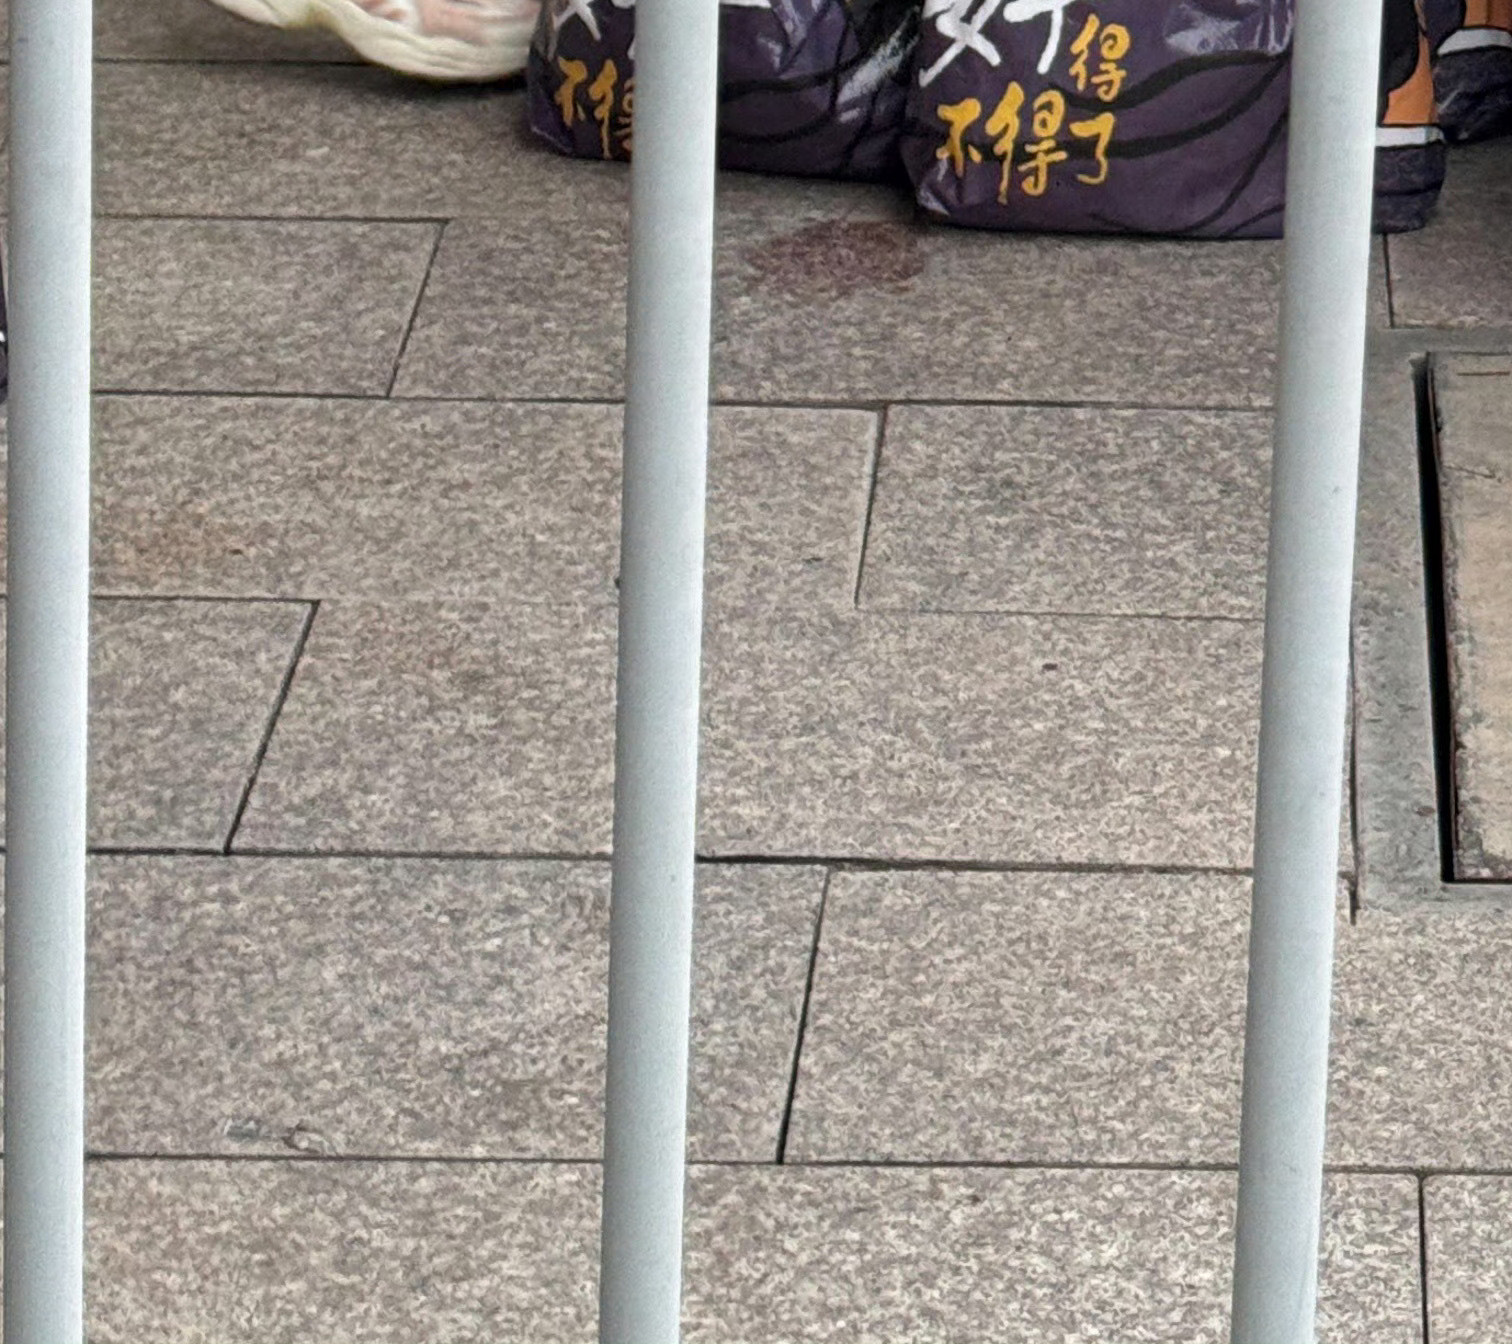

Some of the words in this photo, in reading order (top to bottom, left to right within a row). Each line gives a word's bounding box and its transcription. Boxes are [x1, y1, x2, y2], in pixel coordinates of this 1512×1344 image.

[1070, 13, 1131, 104] 得
[936, 80, 1116, 207] 不得了
